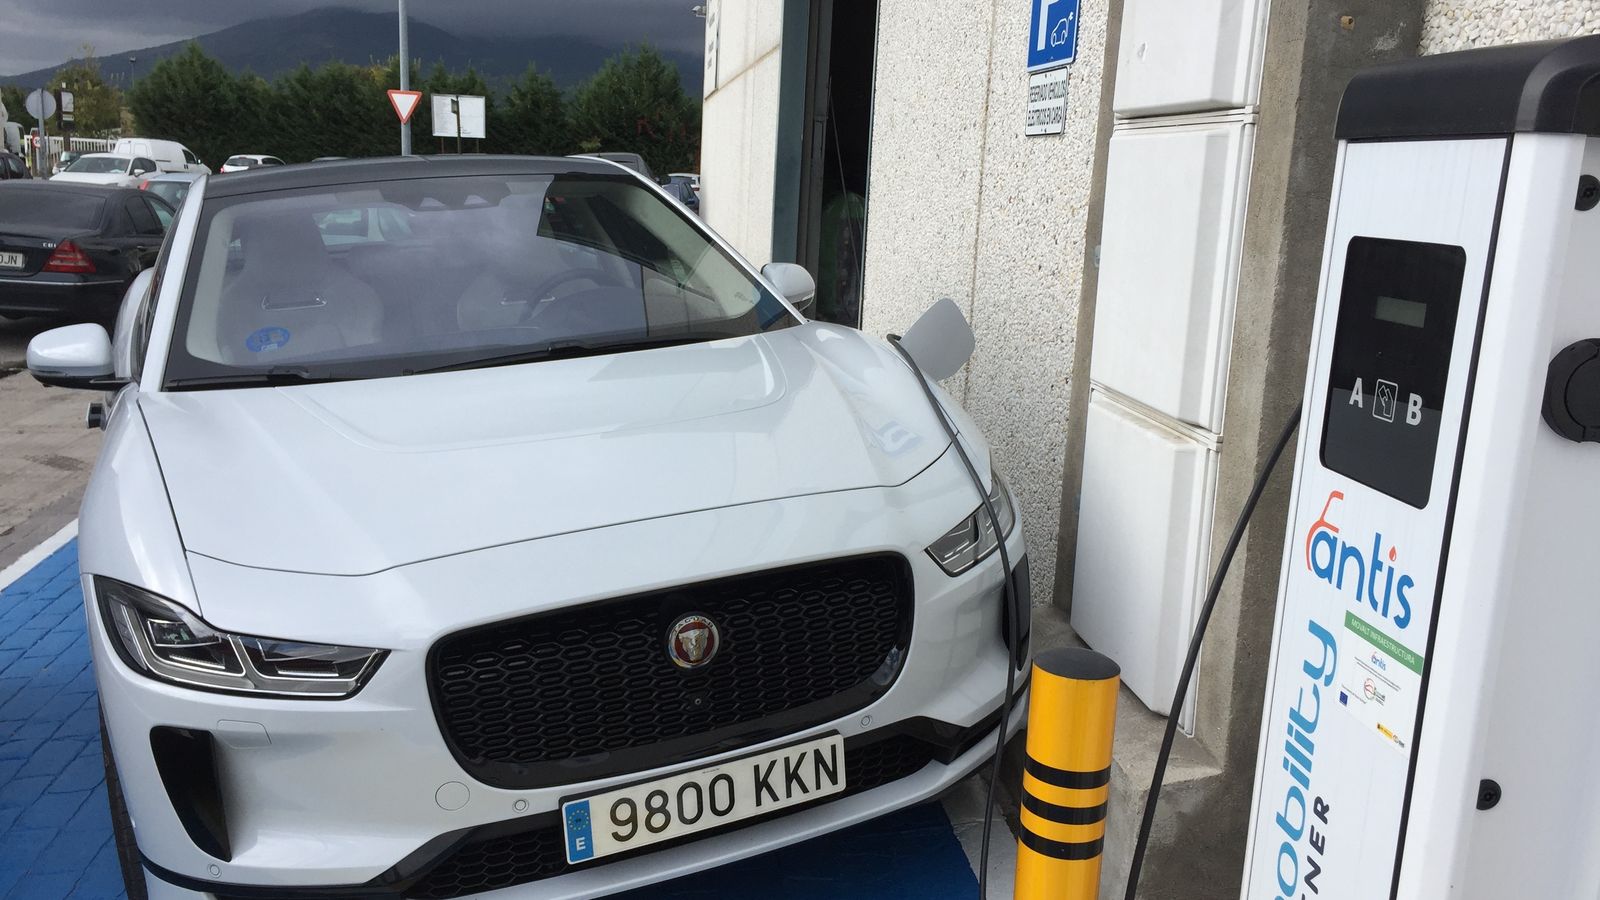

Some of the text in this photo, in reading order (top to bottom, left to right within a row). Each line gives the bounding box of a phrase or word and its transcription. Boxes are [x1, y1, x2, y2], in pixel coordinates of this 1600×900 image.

[1349, 377, 1423, 426] A B
[1351, 618, 1416, 665] MOVALT INFRAESTRUCTURA
[609, 743, 839, 843] 9800 KKN
[1273, 619, 1338, 900] obility
[575, 836, 586, 852] E
[1302, 796, 1330, 900] NER
